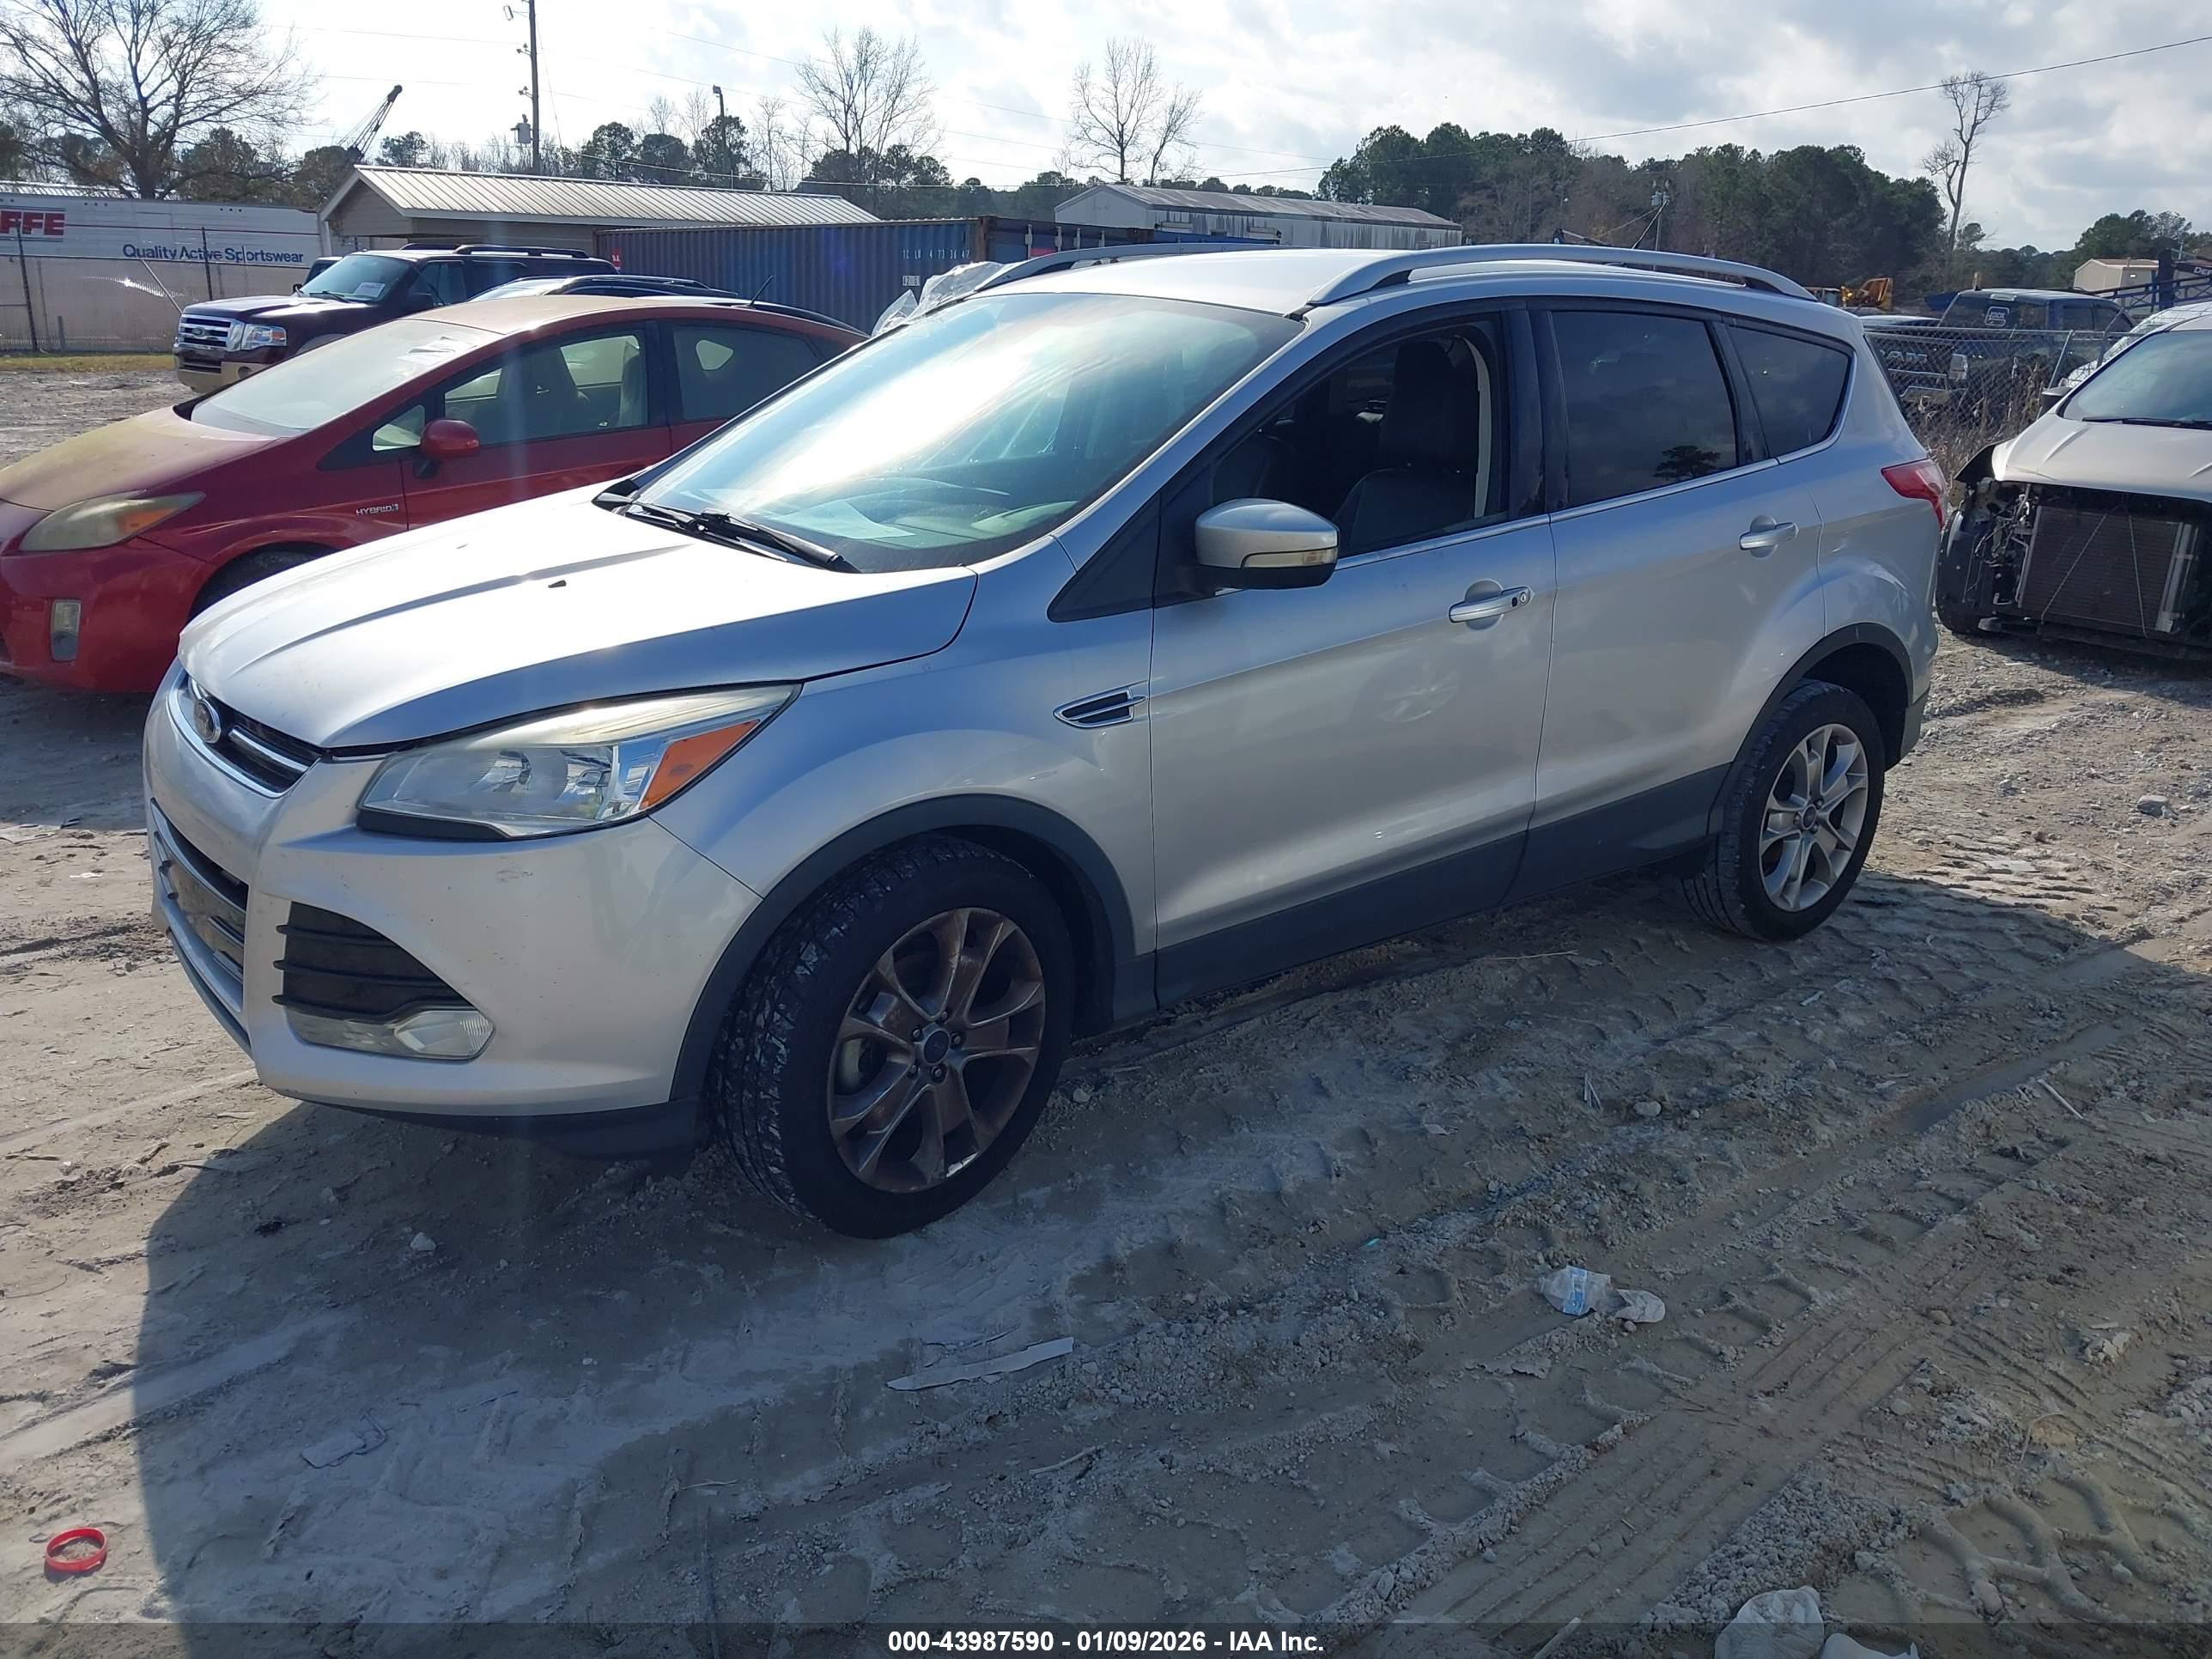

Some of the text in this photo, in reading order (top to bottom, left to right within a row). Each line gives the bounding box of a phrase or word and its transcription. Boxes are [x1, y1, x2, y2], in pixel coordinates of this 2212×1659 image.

[0, 210, 64, 235] FFE
[123, 244, 177, 259] Quality
[224, 248, 304, 263] Sportswear
[356, 505, 392, 516] HYBRID
